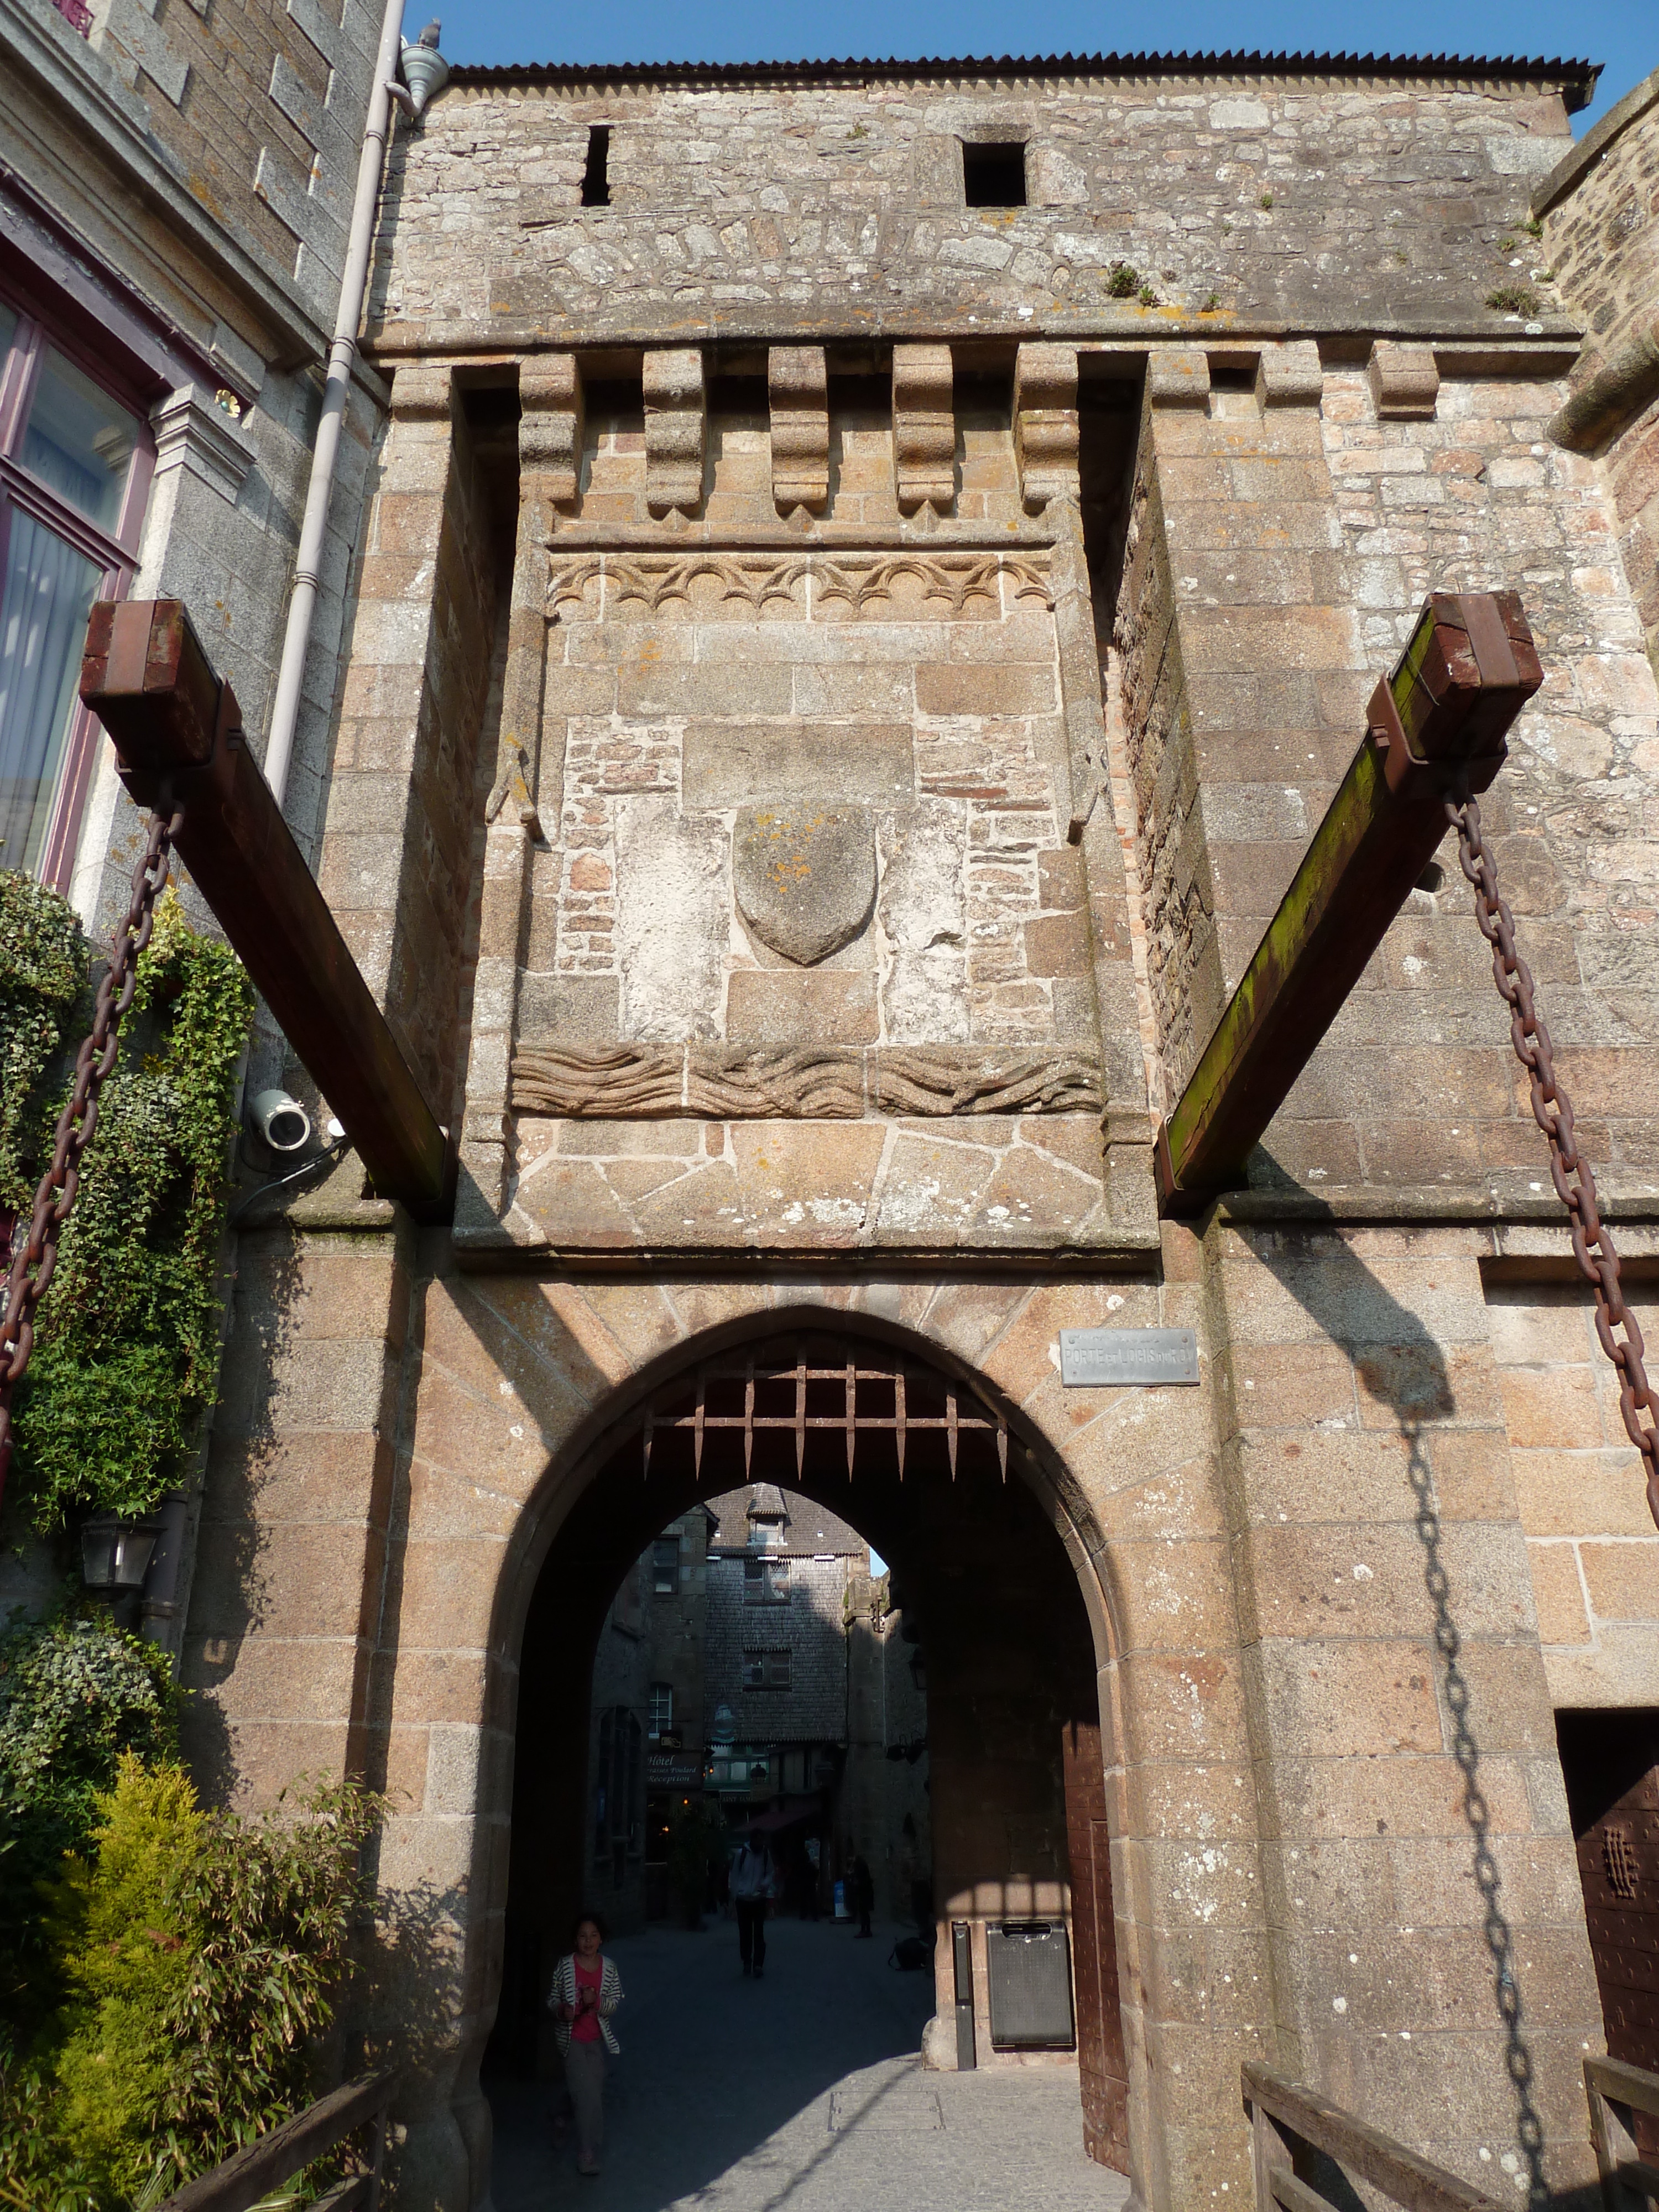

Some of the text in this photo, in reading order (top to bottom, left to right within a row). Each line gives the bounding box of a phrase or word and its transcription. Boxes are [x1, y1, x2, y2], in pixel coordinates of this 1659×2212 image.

[1065, 1347, 1194, 1364] PORTE ET LOGIS DU ROY
[648, 1755, 675, 1766] Hôtel
[647, 1775, 691, 1785] Réception
